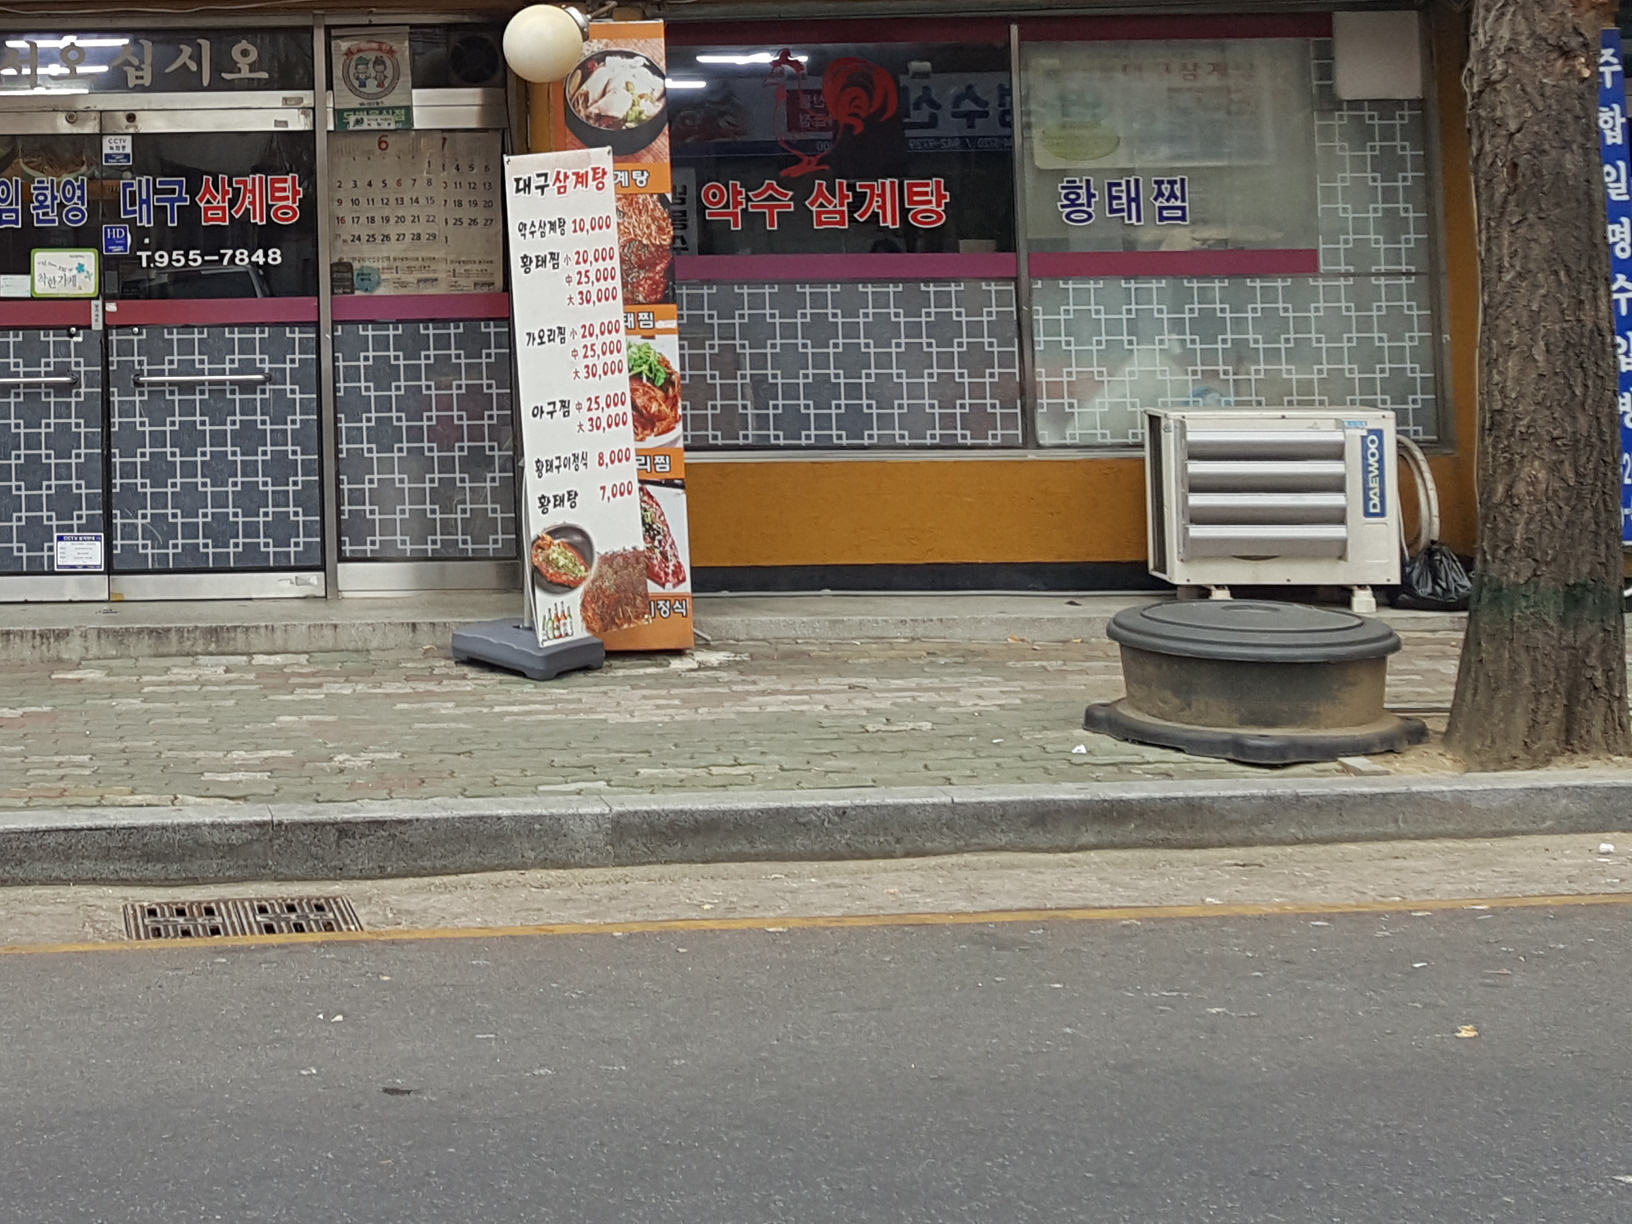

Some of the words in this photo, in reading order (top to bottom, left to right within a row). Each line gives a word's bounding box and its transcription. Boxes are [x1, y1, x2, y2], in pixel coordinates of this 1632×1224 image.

[377, 134, 390, 151] 6
[427, 160, 431, 168] 1
[336, 180, 343, 188] 2
[351, 180, 358, 188] 3
[366, 180, 373, 188] 4
[381, 179, 388, 188] 5
[396, 179, 402, 187] 6
[411, 179, 417, 187] 7
[426, 178, 433, 187] 8
[513, 166, 608, 196] 대구삼계탕
[30, 176, 88, 227] 환영
[120, 176, 190, 227] 대구
[195, 173, 303, 226] 삼계탕
[336, 198, 343, 207] 9
[350, 198, 360, 207] 10
[366, 198, 375, 206] 11
[380, 198, 390, 206] 12
[395, 197, 405, 206] 13
[409, 197, 420, 205] 14
[425, 196, 435, 205] 15
[1057, 176, 1189, 226] 황태찜
[336, 216, 346, 225] 16
[351, 216, 361, 225] 17
[366, 216, 376, 224] 18
[380, 216, 391, 224] 19
[394, 215, 406, 224] 20
[410, 215, 421, 223] 21
[425, 215, 436, 223] 22
[517, 217, 567, 240] 약수삼계탕
[571, 215, 612, 236] 10,000
[107, 228, 125, 238] HD
[136, 248, 282, 268] T.955-7848
[520, 251, 560, 275] 황태찜
[563, 254, 572, 266] 小
[574, 246, 615, 267] 20,000
[565, 273, 573, 286] 中
[576, 266, 617, 287] 25,000
[567, 294, 575, 306] 大
[577, 286, 618, 307] 30,000
[525, 325, 567, 347] 가오리찜
[569, 327, 578, 340] 小
[580, 319, 621, 340] 20,000
[571, 347, 579, 361] 中
[582, 339, 623, 361] 25,000
[572, 368, 581, 380] 大
[583, 359, 624, 381] 30,000
[531, 399, 571, 420] 아구찜
[575, 400, 583, 413] 中
[586, 391, 627, 413] 25,000
[577, 421, 585, 433] 大
[588, 412, 628, 434] 30,000
[534, 451, 589, 479] 황태구이정식
[597, 447, 632, 470] 8,000
[1367, 434, 1381, 513] DAEWOO
[537, 489, 579, 515] 황태탕
[599, 480, 634, 503] 7,000
